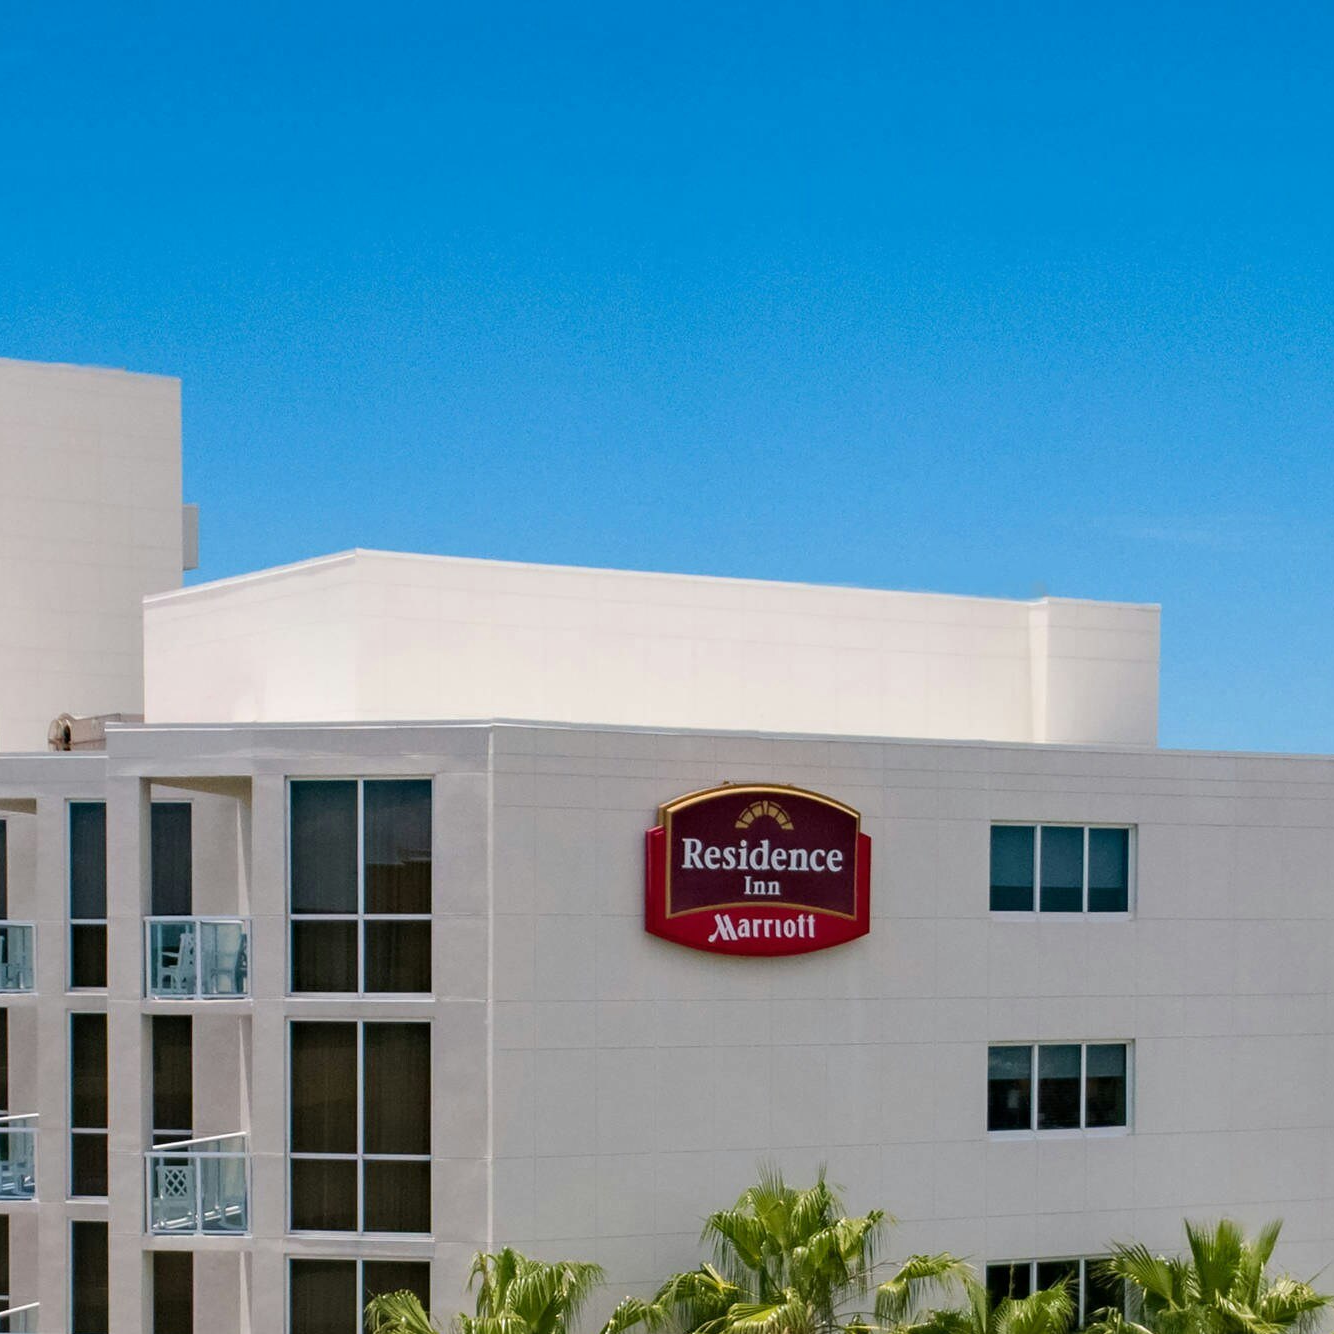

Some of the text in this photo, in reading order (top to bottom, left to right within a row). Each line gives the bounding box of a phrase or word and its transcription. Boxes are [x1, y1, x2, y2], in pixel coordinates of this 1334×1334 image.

[681, 838, 843, 872] Residence
[744, 876, 781, 895] Inn
[708, 914, 816, 943] Marriott
